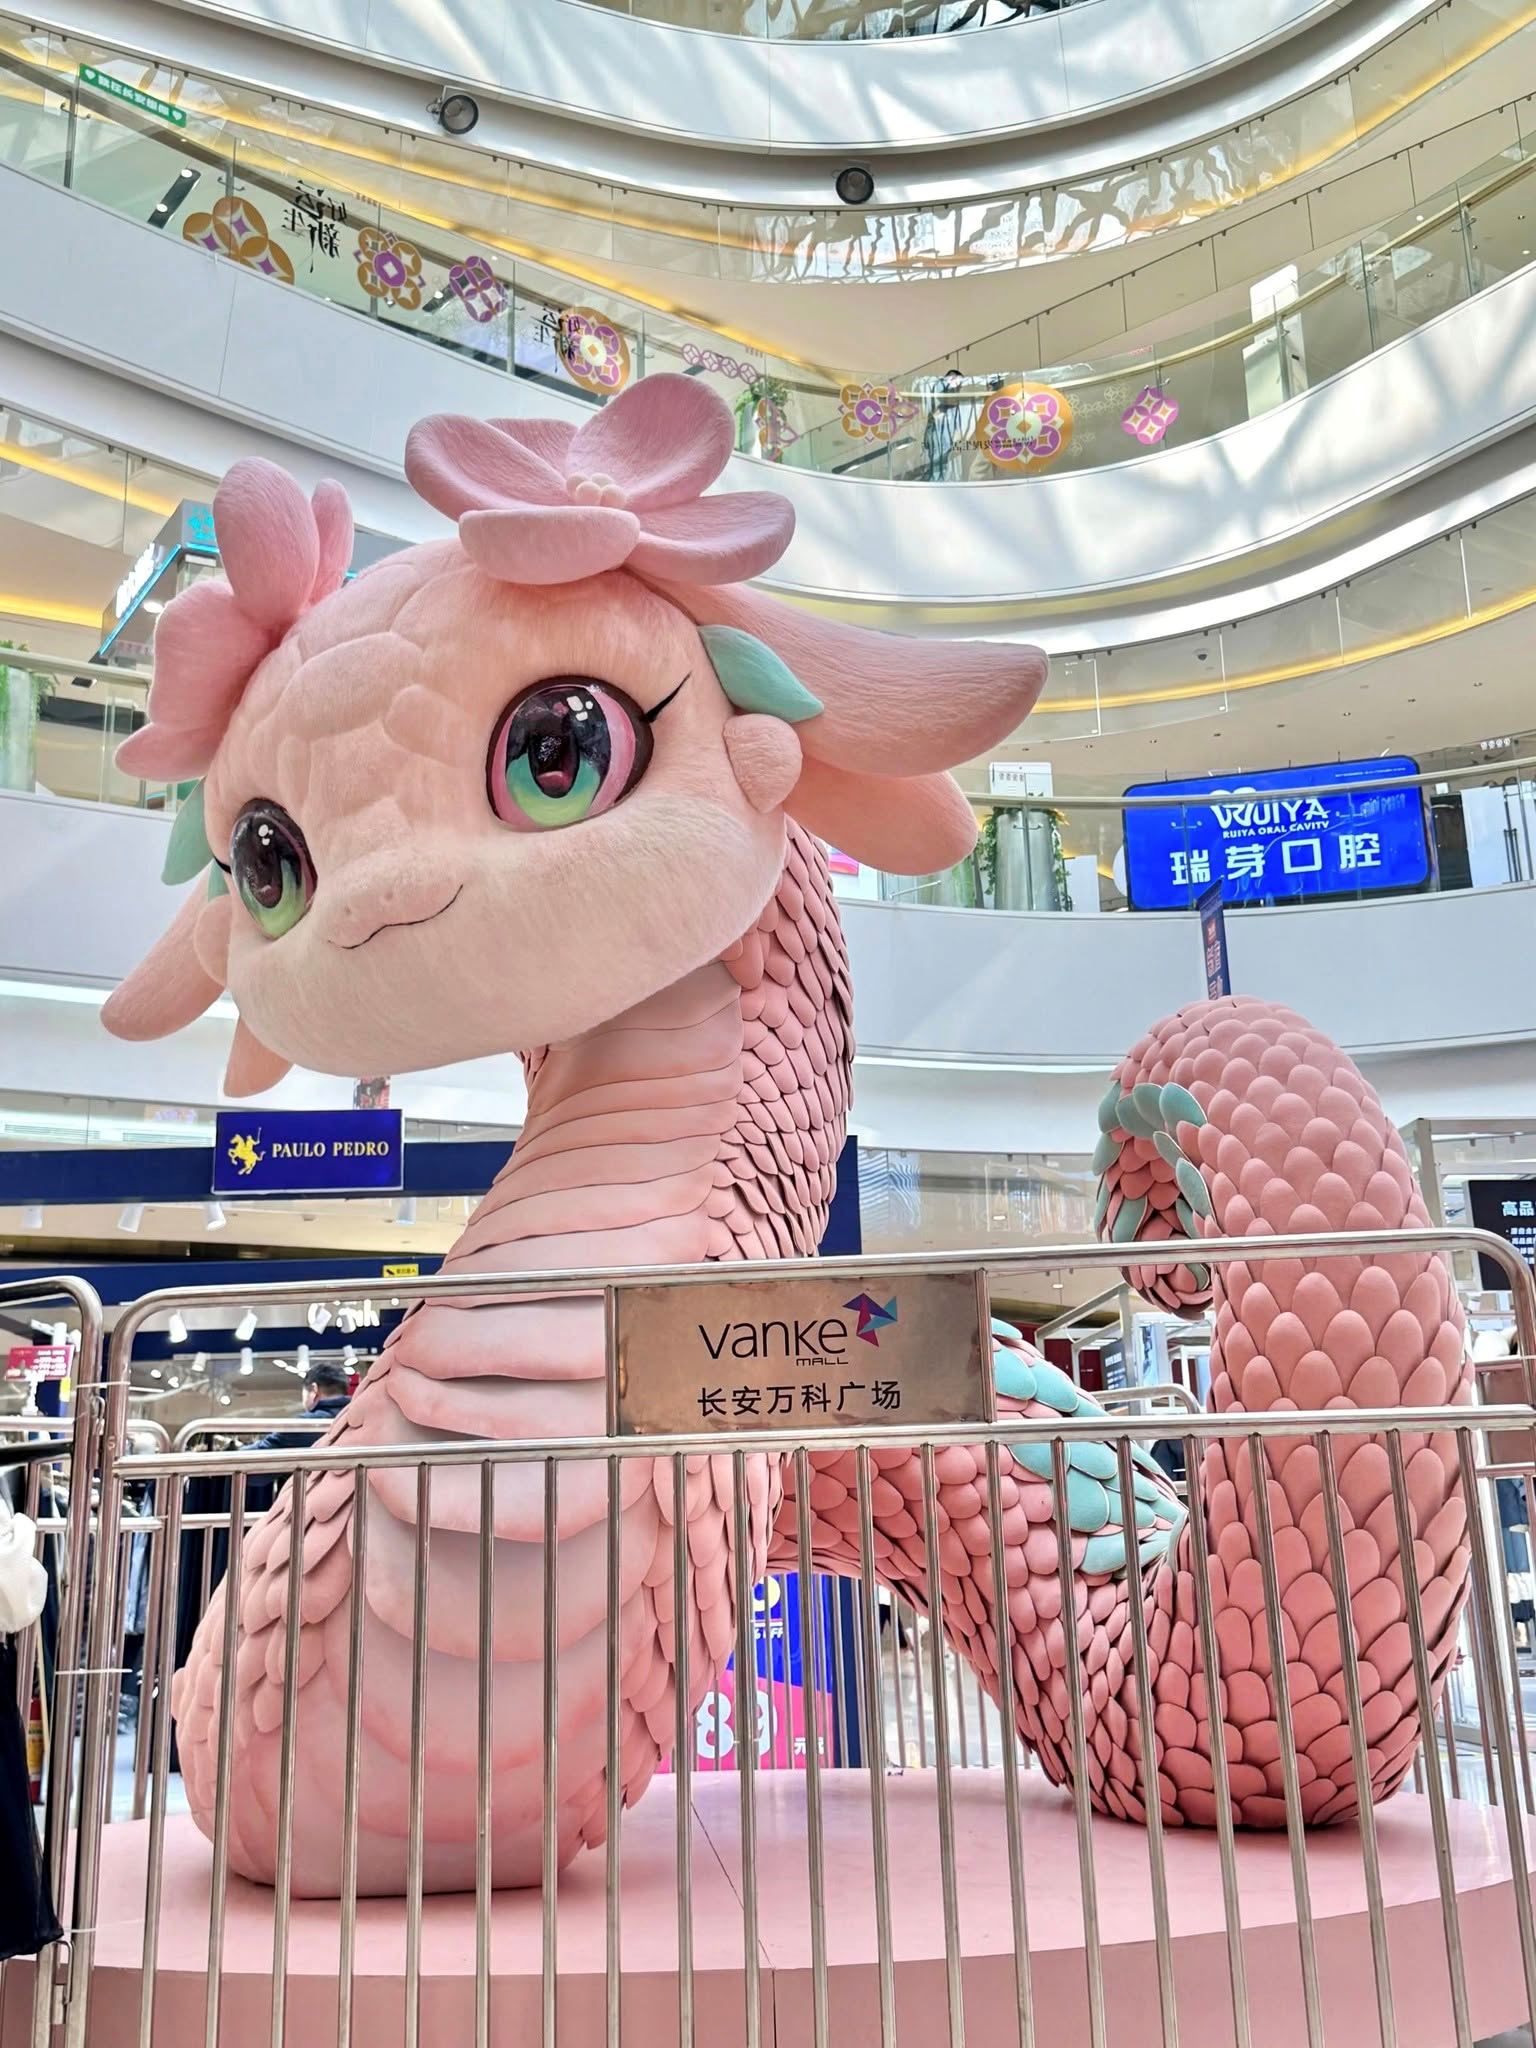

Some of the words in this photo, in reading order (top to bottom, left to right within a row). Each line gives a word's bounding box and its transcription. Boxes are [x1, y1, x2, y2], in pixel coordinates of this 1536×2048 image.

[1223, 828, 1256, 839] RUIYA
[1258, 825, 1287, 835] ORAL
[1289, 820, 1330, 832] CAVITY
[1170, 832, 1382, 886] 瑞芽口腔
[272, 1142, 326, 1158] PAULO
[333, 1141, 389, 1156] PEDRO
[1501, 1200, 1536, 1216] 高品
[698, 1318, 848, 1360] vanke
[796, 1356, 849, 1367] MALL
[697, 1380, 901, 1417] 长安万科广场
